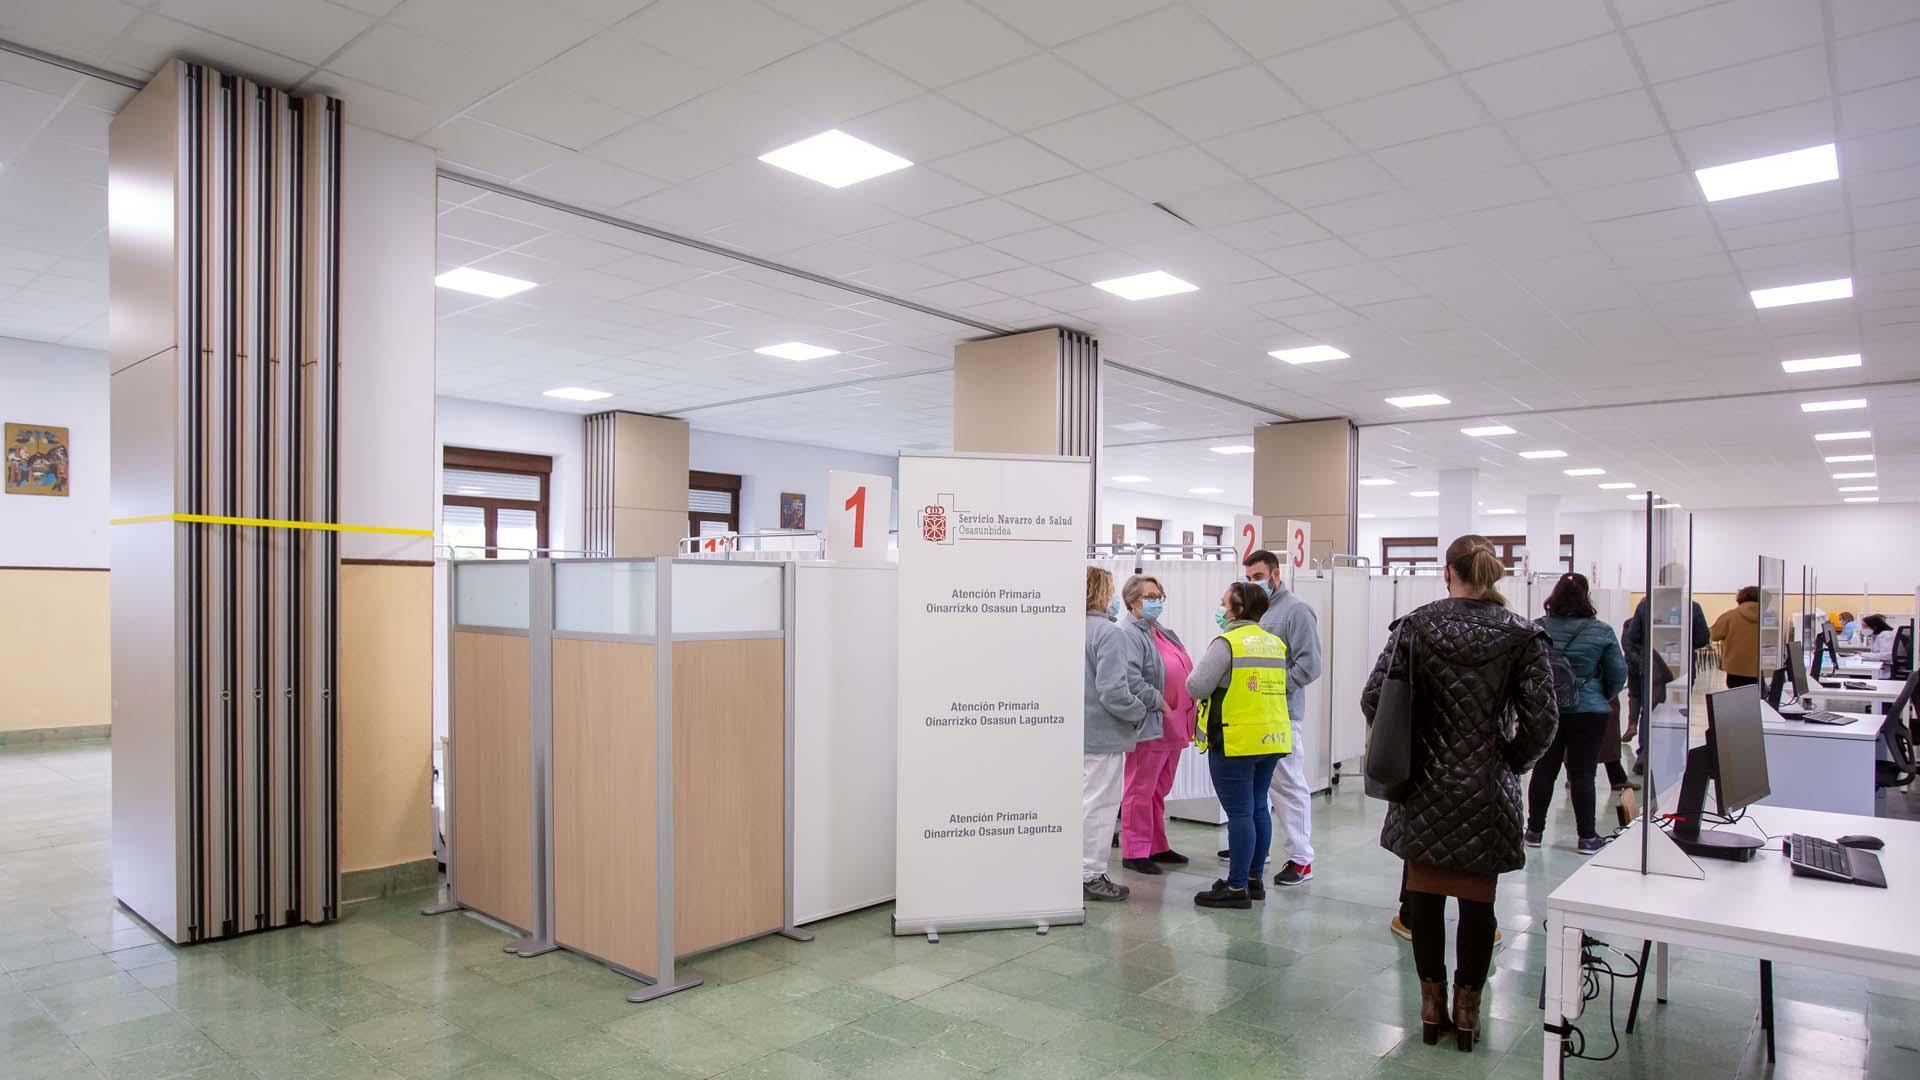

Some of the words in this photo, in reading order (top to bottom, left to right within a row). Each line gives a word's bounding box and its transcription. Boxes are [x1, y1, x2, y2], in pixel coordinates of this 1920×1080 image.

[845, 486, 866, 548] 1
[959, 514, 994, 524] Servicio
[997, 515, 1033, 525] Navarro
[1035, 515, 1046, 525] de
[1050, 515, 1073, 525] Salud
[958, 525, 1012, 536] Osasunbidea
[1243, 523, 1256, 564] 2
[1294, 528, 1305, 568] 3
[951, 588, 997, 600] Atención
[999, 589, 1041, 600] Primaria
[926, 603, 979, 614] Oinarrizko
[981, 603, 1018, 614] Osasun
[1020, 603, 1067, 615] Laguntza
[950, 701, 996, 712] Atención
[998, 700, 1040, 711] Primaria
[925, 716, 978, 727] Oinarrizko
[980, 715, 1017, 726] Osasun
[1019, 714, 1065, 727] Laguntza
[949, 812, 994, 823] Atención
[996, 811, 1038, 822] Primaria
[924, 828, 976, 839] Oinarrizko
[978, 826, 1015, 837] Osasun
[1018, 824, 1062, 837] Laguntza
